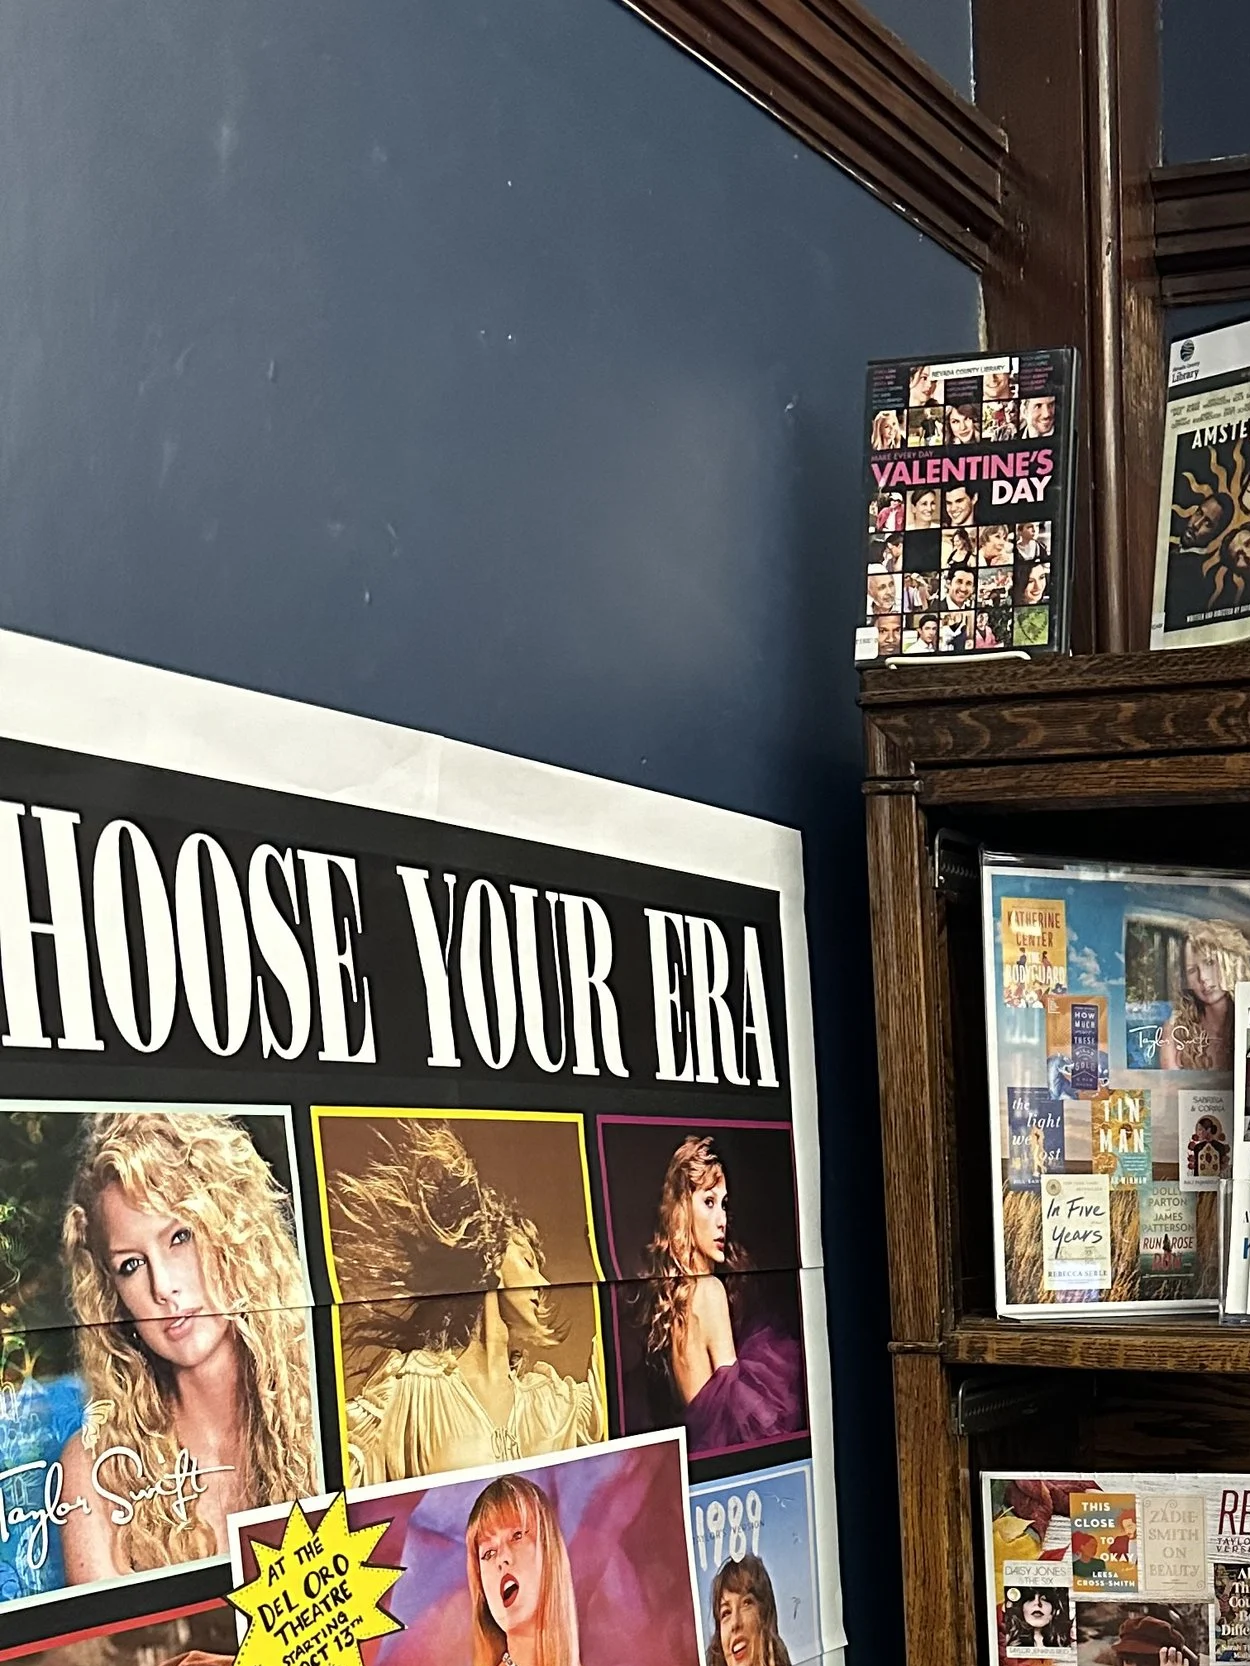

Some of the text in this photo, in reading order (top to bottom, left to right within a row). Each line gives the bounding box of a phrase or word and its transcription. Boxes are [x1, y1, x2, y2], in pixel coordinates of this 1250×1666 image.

[871, 450, 1053, 487] VALENTINE'S
[992, 476, 1049, 506] DAY
[398, 866, 630, 1079] YOUR
[645, 908, 780, 1089] ERA
[1028, 1113, 1061, 1128] light
[1101, 1098, 1140, 1122] TIN
[1100, 1128, 1144, 1152] MAN
[1053, 1226, 1103, 1259] Years
[1082, 1503, 1110, 1512] THIS
[696, 1490, 762, 1572] 1989
[1074, 1519, 1114, 1528] CLOSE
[1101, 1537, 1114, 1545] TO
[268, 1538, 324, 1586] AT THE
[1101, 1553, 1133, 1561] OKAY
[258, 1554, 349, 1632] DEL ORO
[274, 1580, 352, 1645] THEATRE
